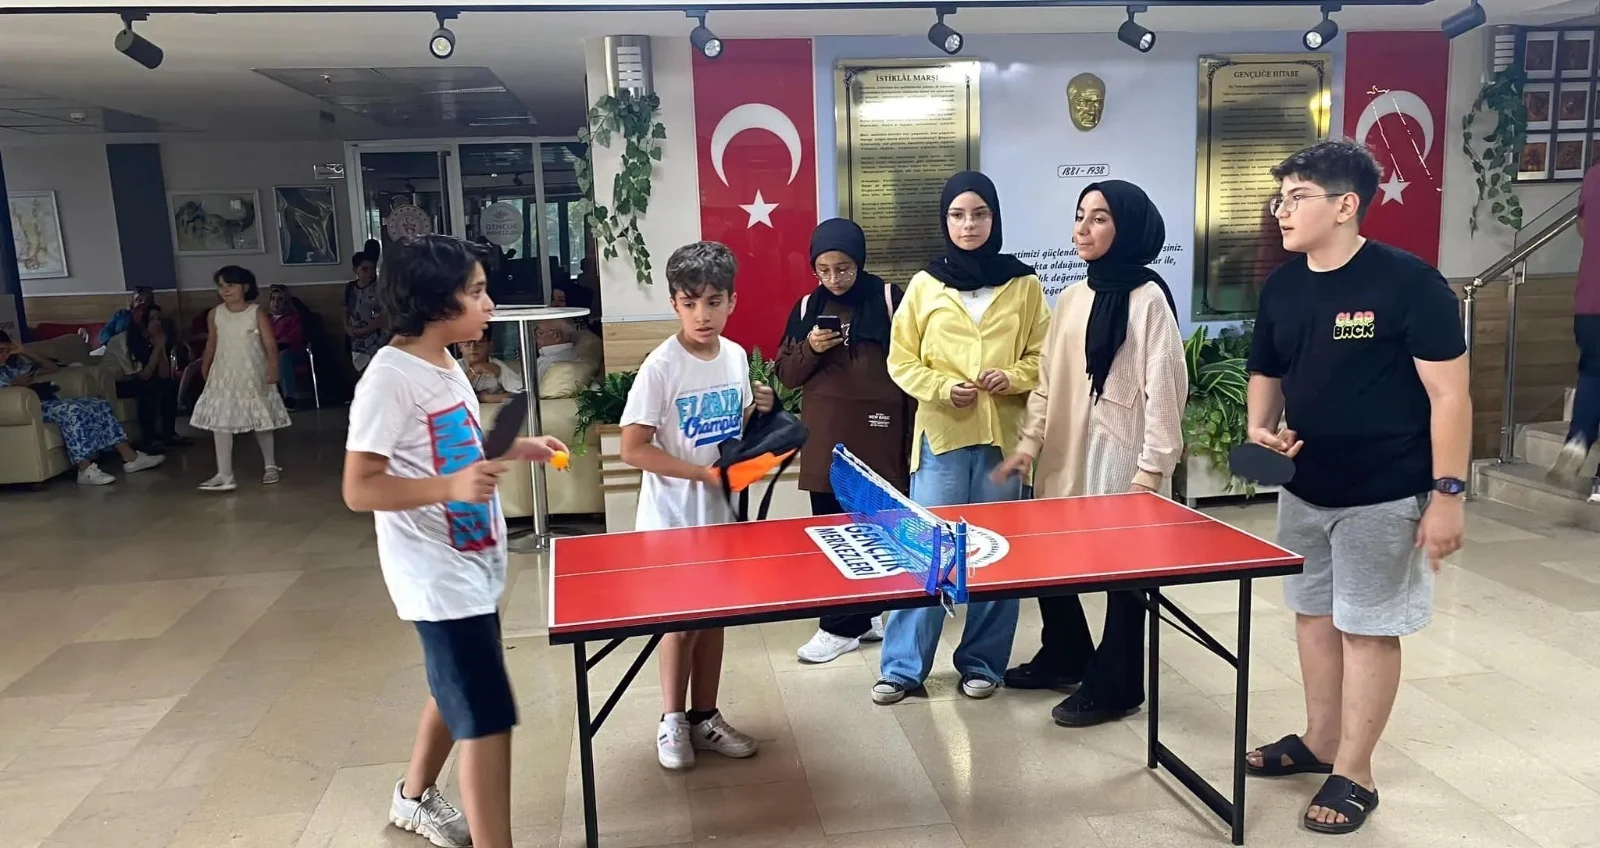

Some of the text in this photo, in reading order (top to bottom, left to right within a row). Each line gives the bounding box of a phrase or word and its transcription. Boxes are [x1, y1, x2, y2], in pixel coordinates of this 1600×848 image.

[1062, 166, 1080, 176] 1881
[1086, 165, 1105, 175] 1938
[1042, 248, 1079, 259] güçlendi
[1162, 243, 1184, 252] siniz.
[1050, 260, 1088, 271] olduğunu
[1051, 272, 1087, 283] değerini
[1335, 310, 1375, 325] CLAP
[1333, 323, 1375, 340] BACK
